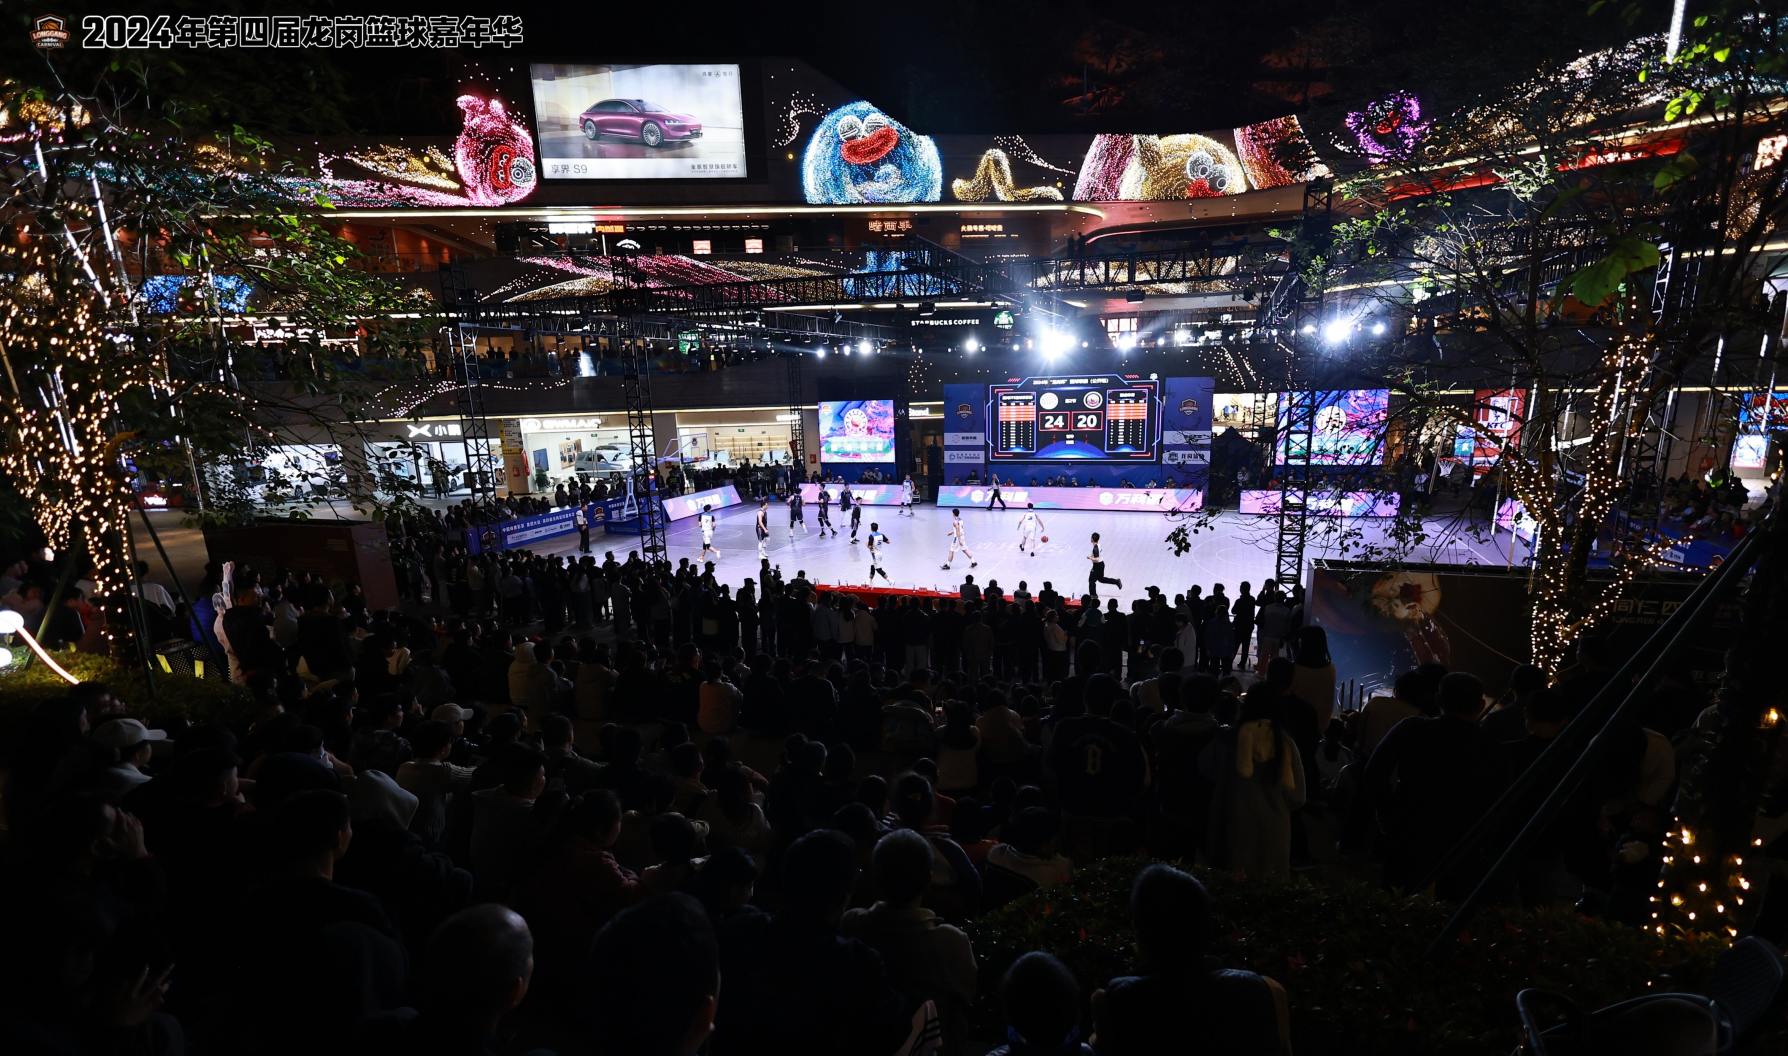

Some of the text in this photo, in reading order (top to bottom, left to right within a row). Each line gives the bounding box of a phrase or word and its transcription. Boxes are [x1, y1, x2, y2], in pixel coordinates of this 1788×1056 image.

[573, 164, 588, 174] S9
[1044, 415, 1097, 428] 24 20
